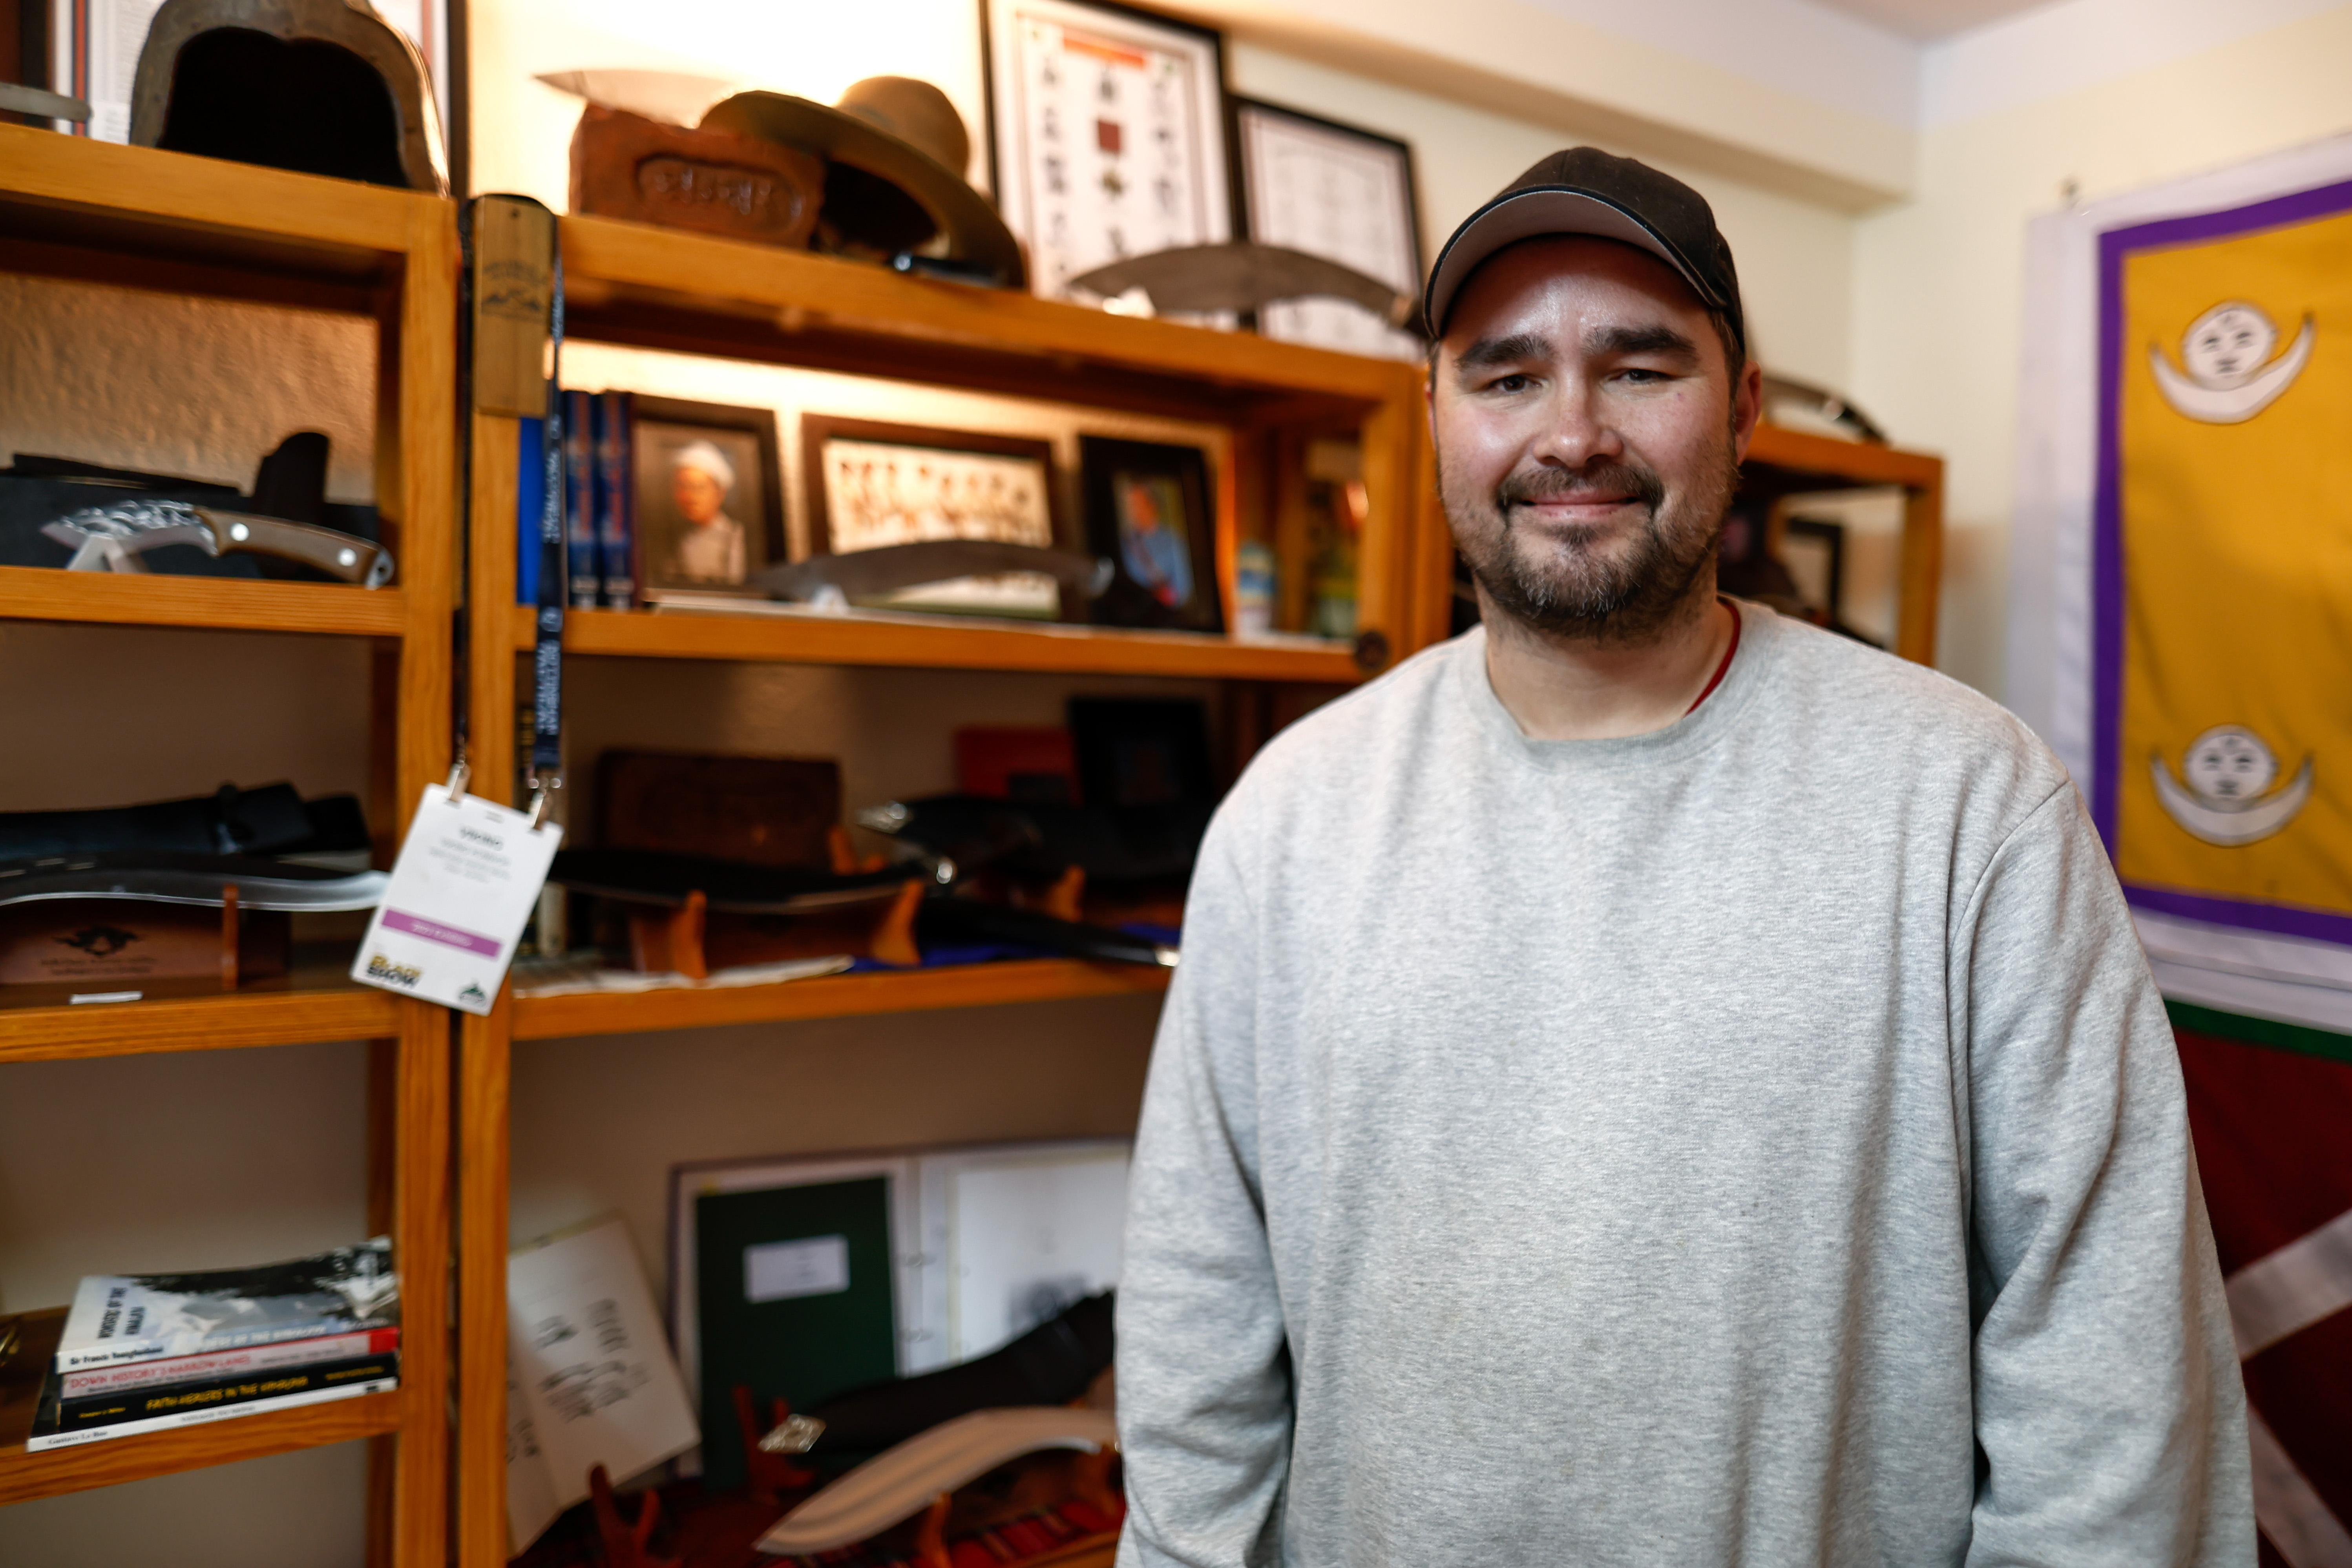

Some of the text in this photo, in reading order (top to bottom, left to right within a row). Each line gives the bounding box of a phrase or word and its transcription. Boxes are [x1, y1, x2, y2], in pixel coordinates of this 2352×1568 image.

[70, 1375, 108, 1388] DOWN
[112, 1367, 167, 1382] HISTORY'S
[239, 1382, 257, 1395] THE
